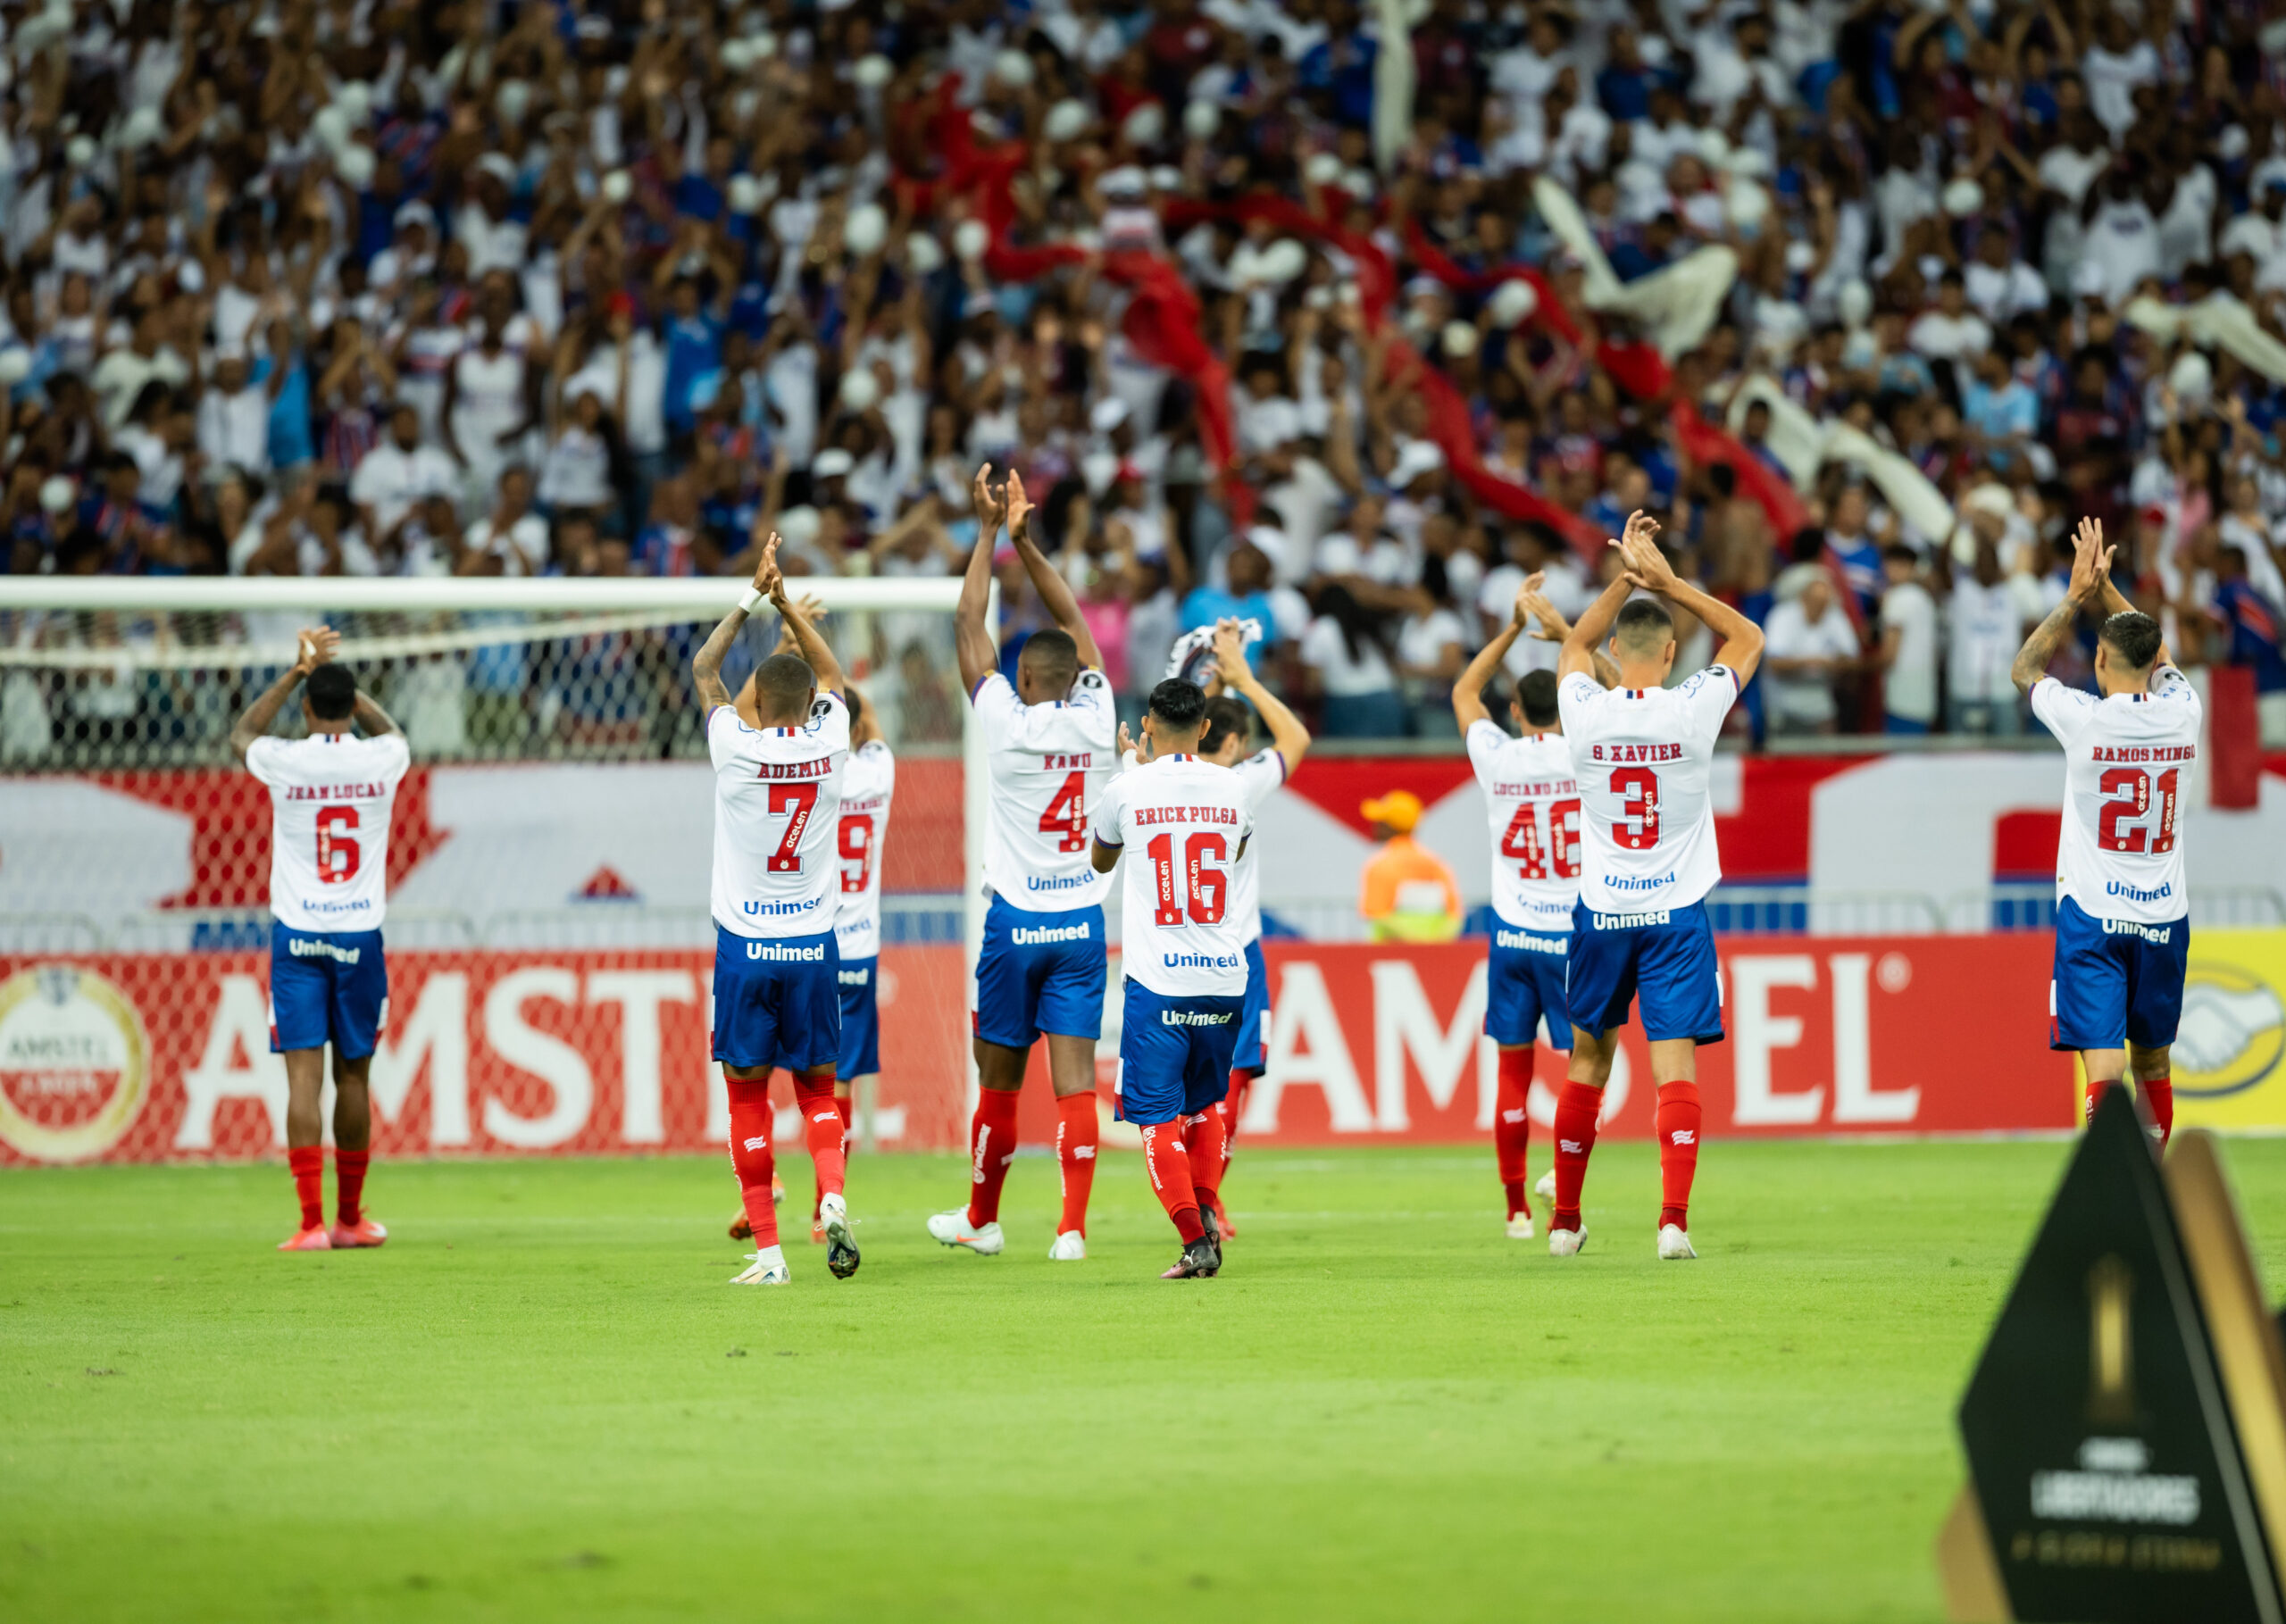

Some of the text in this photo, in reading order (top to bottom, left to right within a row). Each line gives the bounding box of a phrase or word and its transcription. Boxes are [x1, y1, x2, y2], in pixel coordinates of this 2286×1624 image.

[1611, 743, 1682, 762] XAVIER
[2091, 744, 2196, 762] RAMOS MINGO
[757, 756, 832, 779] ADEMIR
[285, 780, 385, 800] JEAN LUCAS
[1493, 780, 1551, 796] LUCIANO
[1039, 770, 1088, 853] 4
[1134, 806, 1238, 826] ERICK PULGA
[1609, 766, 1662, 850] 3
[2098, 767, 2180, 856] 21
[766, 781, 822, 876] 7
[785, 810, 808, 849] acelen
[316, 805, 360, 885] 6
[1027, 869, 1094, 891] Unimed
[1147, 831, 1229, 929] 16
[1191, 859, 1199, 900] acelen
[1604, 871, 1675, 890] Unimed
[2107, 881, 2171, 902] Unimed
[1592, 910, 1671, 930] Unimed
[2101, 919, 2172, 944] Unimed
[1012, 921, 1089, 945] Unimed
[1496, 929, 1568, 954] Unimed
[288, 938, 361, 964] Unimed
[747, 942, 825, 962] Unimed
[1164, 953, 1239, 968] Unimed
[1161, 1010, 1233, 1027] Unimed
